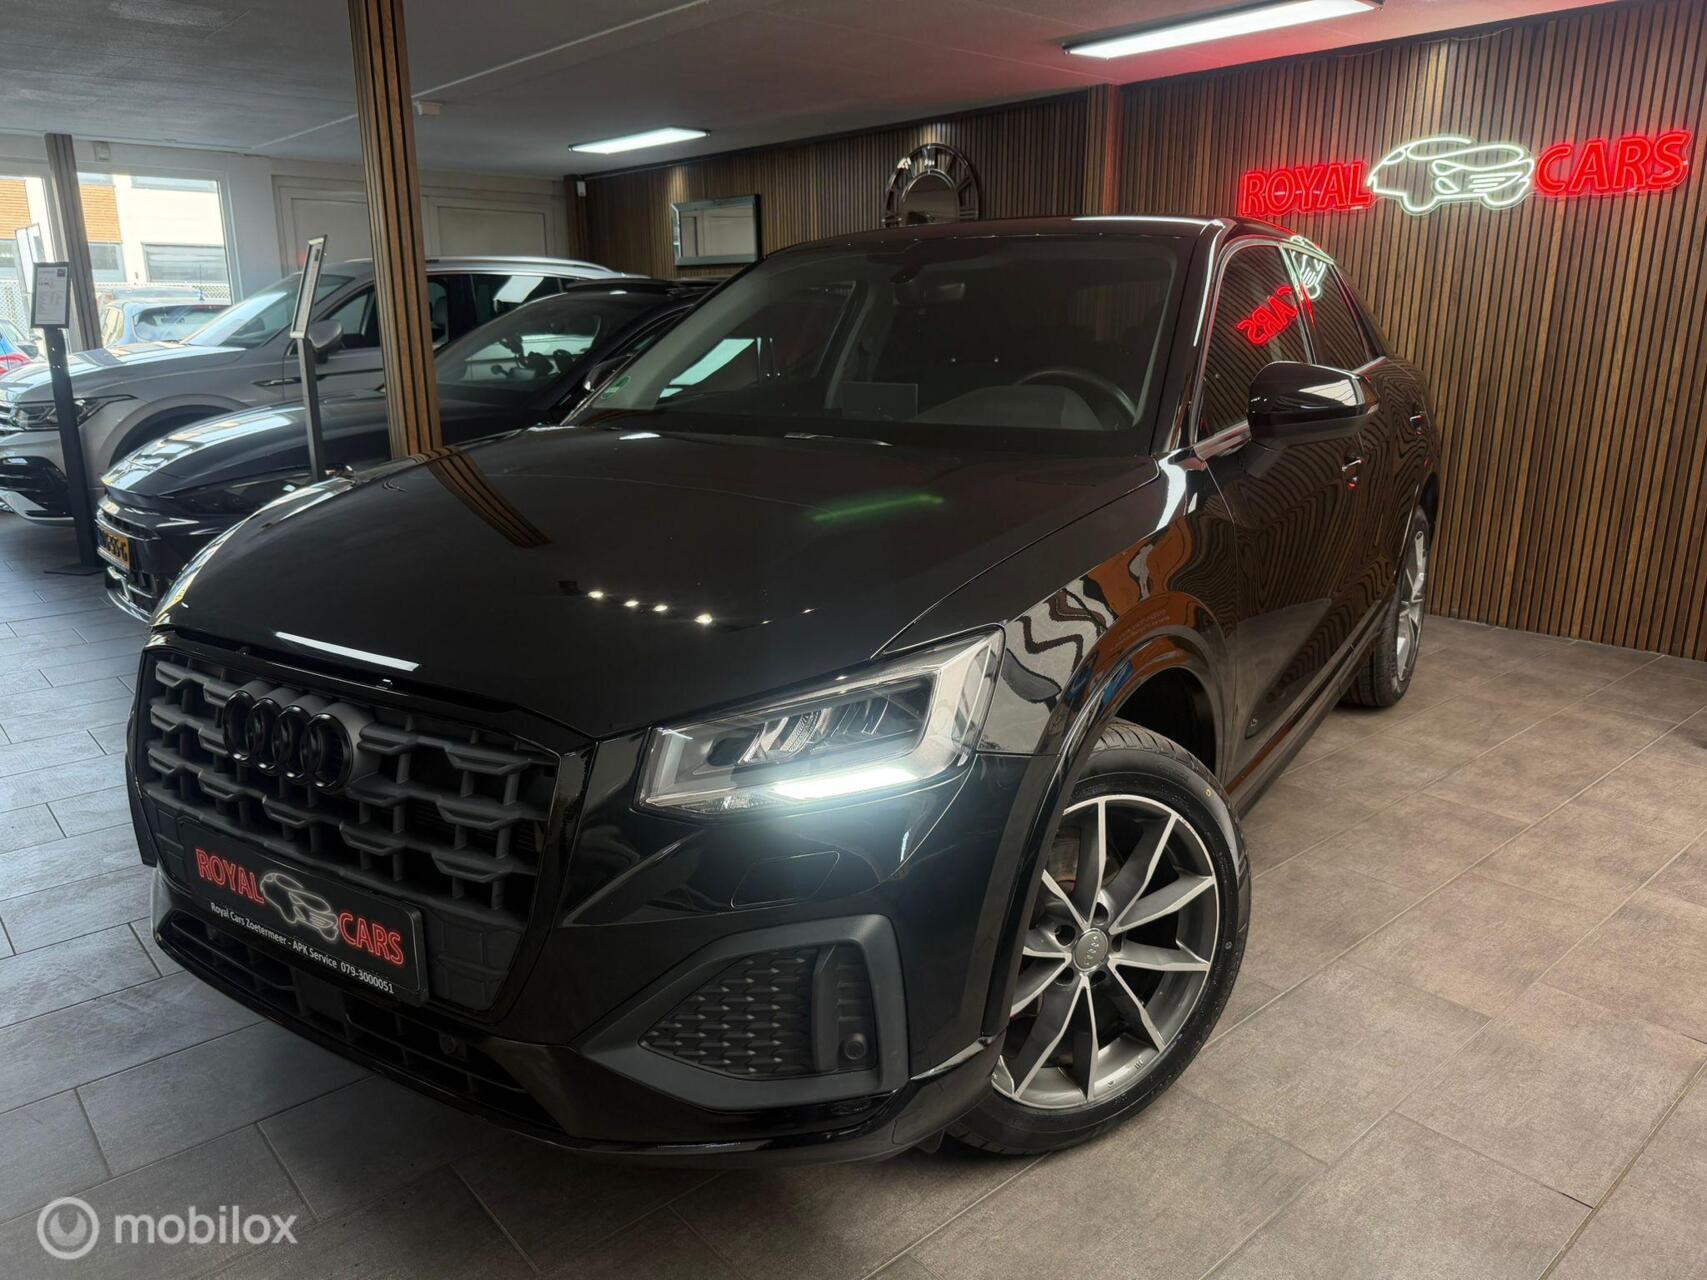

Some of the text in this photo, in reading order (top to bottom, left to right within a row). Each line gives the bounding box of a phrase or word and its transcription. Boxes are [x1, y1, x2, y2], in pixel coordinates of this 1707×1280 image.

[1241, 132, 1689, 214] ROYAL CARS
[195, 849, 404, 965] ROYAL CARS
[210, 902, 230, 919] Royal
[230, 911, 246, 926] Cars
[246, 918, 287, 945] Zoetermeer
[292, 940, 309, 956] APK
[309, 947, 338, 969] Service
[340, 961, 395, 995] 079-3000051
